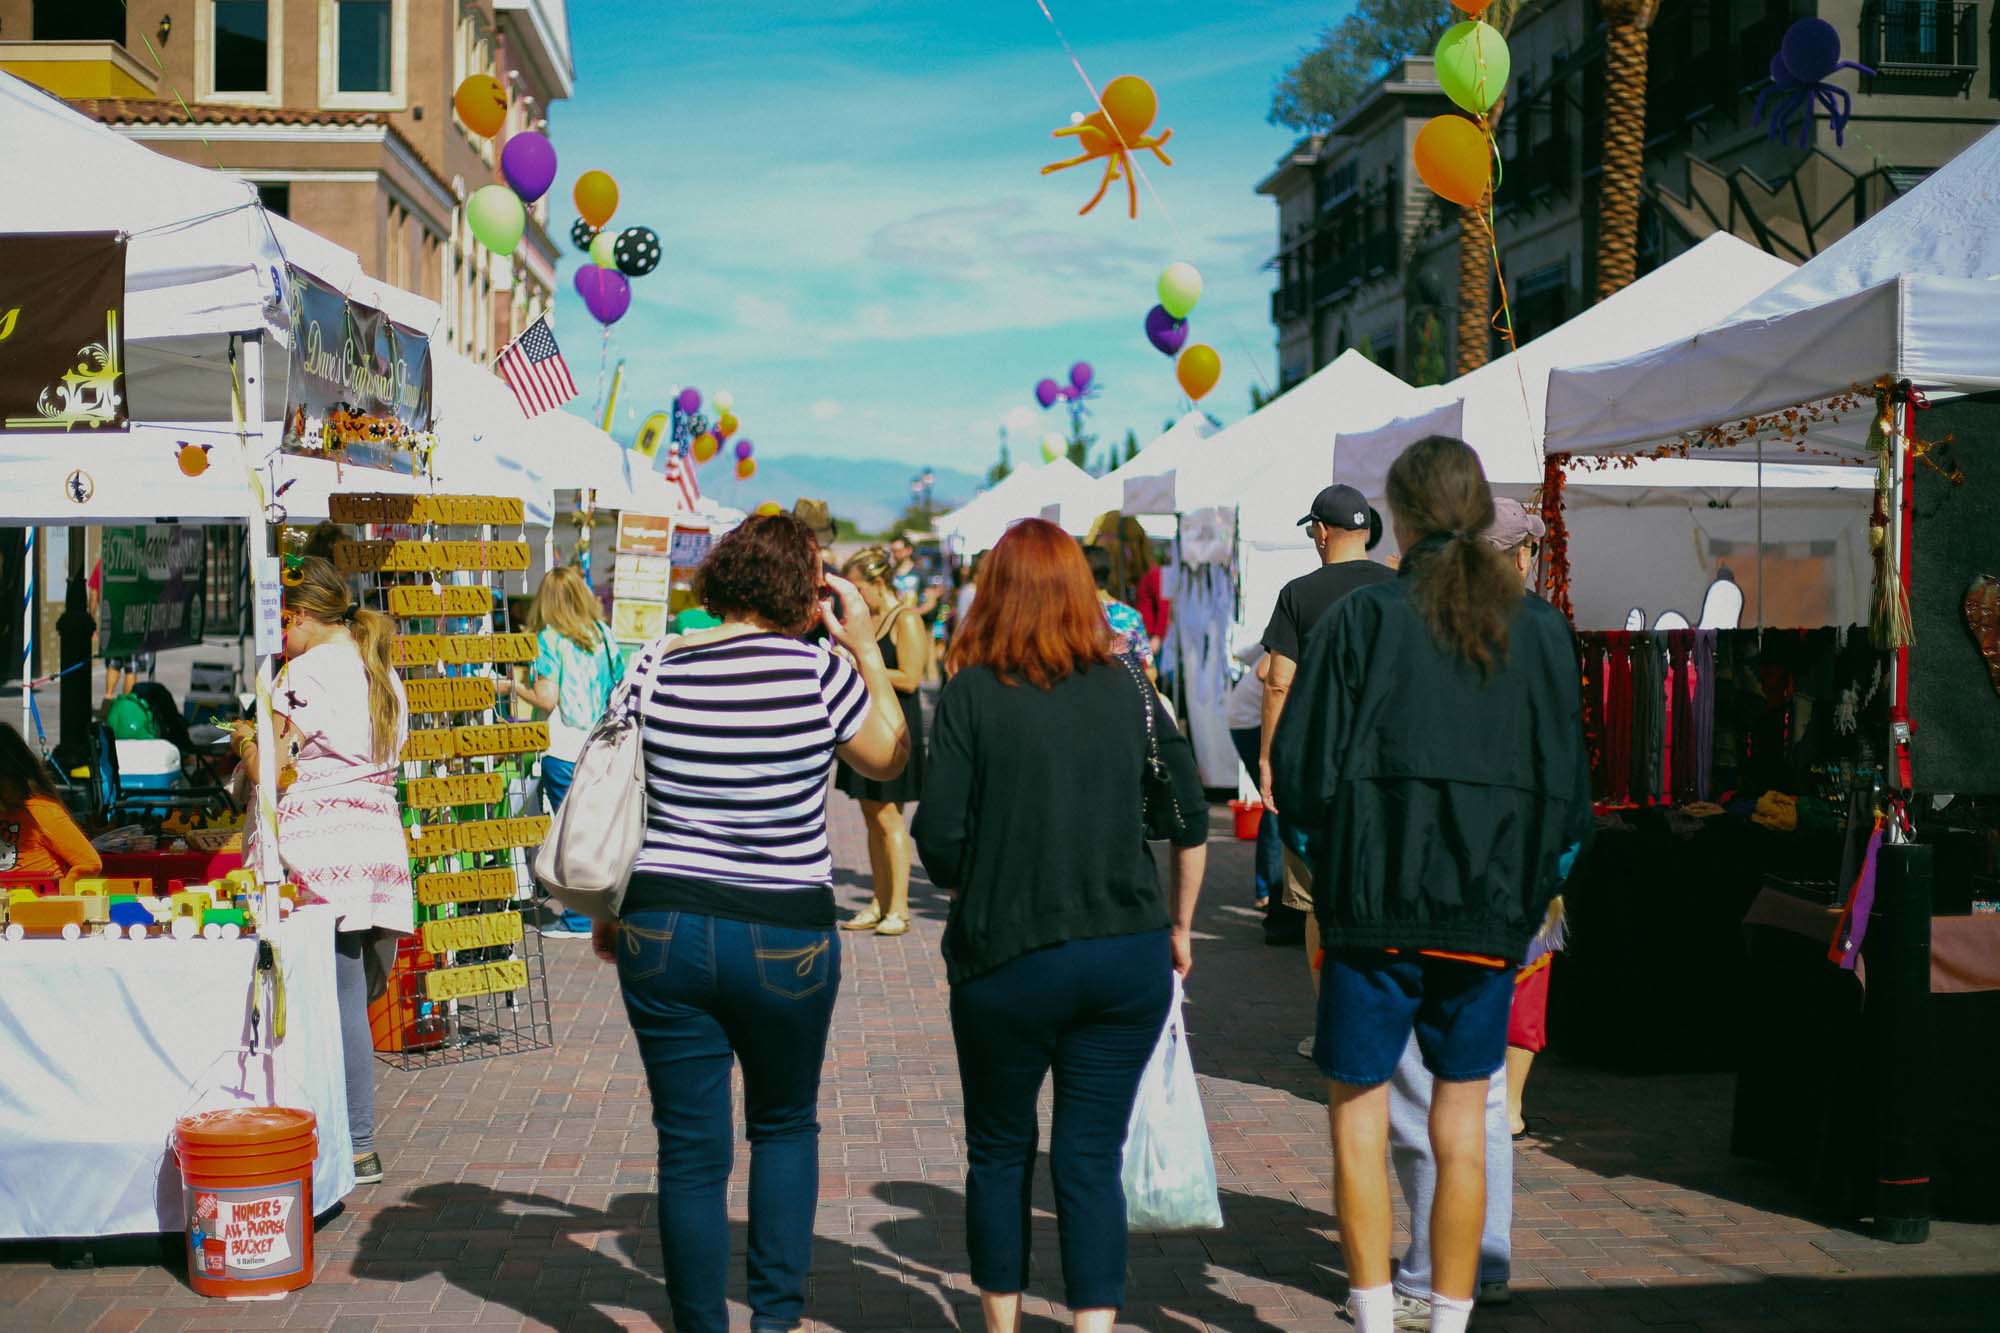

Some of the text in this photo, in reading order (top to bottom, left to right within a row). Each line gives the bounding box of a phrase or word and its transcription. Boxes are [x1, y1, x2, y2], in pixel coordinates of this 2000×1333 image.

[304, 320, 341, 385] Dave's
[337, 496, 429, 521] VETERAN
[434, 499, 523, 522] VETERAN
[341, 543, 431, 569] VETERAN
[440, 544, 525, 568] VETERAN
[401, 588, 490, 611] VETERAN
[450, 636, 534, 659] VETERAN
[461, 725, 548, 752] SISTERS
[415, 775, 501, 805] FAMILY
[466, 818, 550, 849] FAMILY
[424, 872, 513, 901] STRENGTH
[430, 912, 519, 951] COURAGE
[439, 962, 524, 996] ALIENS
[231, 1238, 274, 1256] BUCKET
